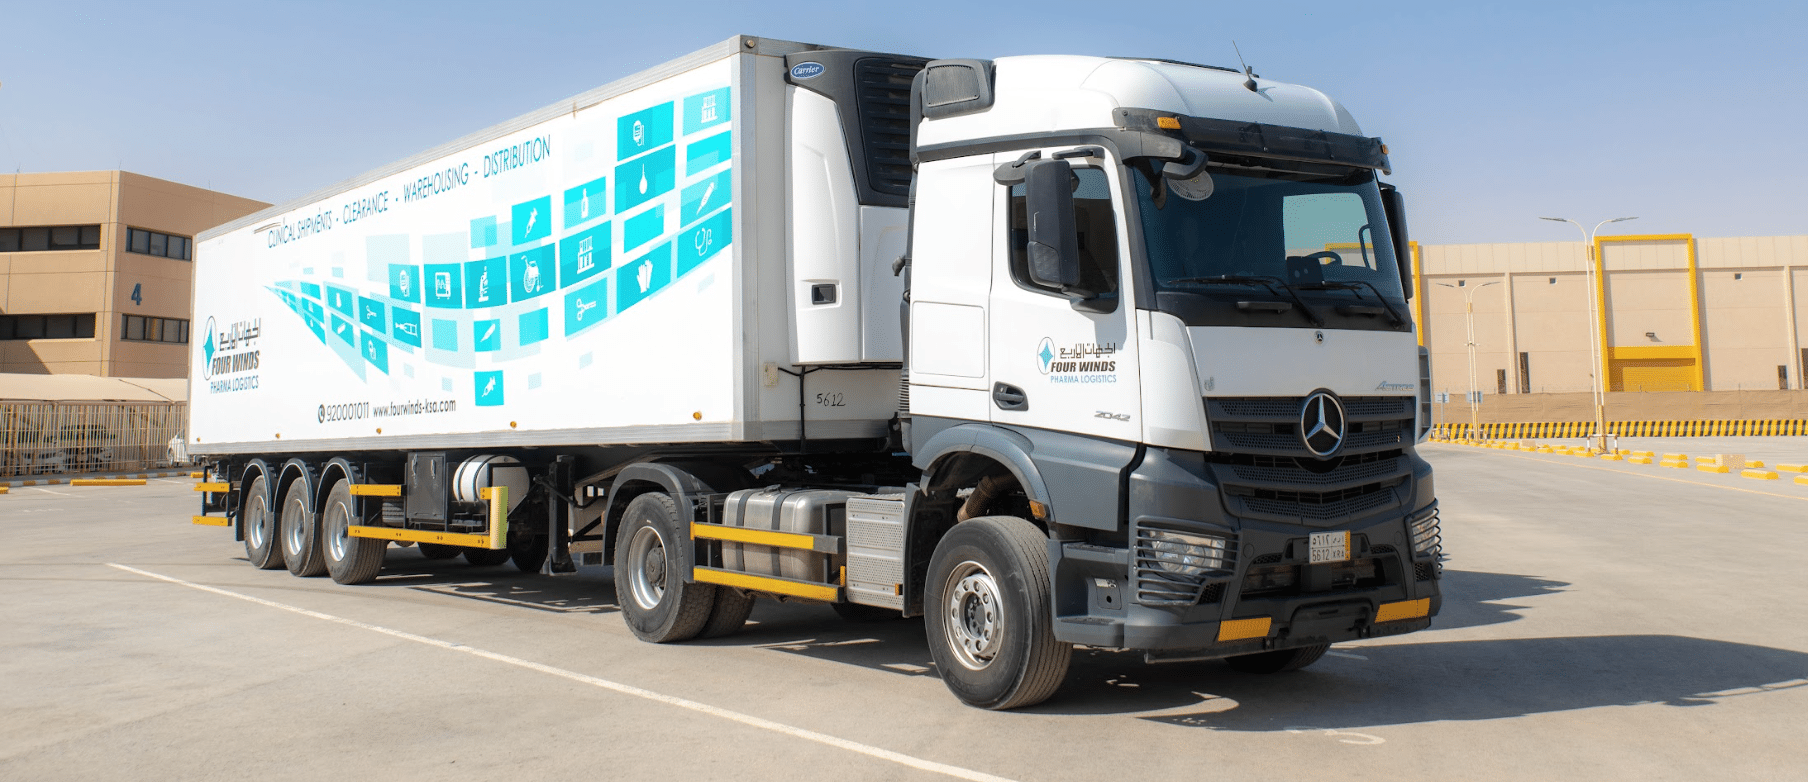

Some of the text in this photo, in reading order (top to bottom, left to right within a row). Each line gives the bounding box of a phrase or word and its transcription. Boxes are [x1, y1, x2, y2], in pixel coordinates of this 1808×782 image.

[793, 65, 820, 75] Carrier
[267, 224, 296, 249] CLINICAL
[297, 210, 333, 240] SHIPMENTS
[343, 190, 389, 225] CLEARANCE
[403, 162, 469, 204] WAREHOUSING
[484, 134, 551, 178] DISTRIBUTION
[131, 283, 142, 306] 4
[211, 349, 260, 376] FOUR WINDS
[1050, 360, 1116, 373] FOUR WINDS
[210, 375, 259, 394] PHARMA LOGISTICS
[1050, 374, 1117, 384] PHARMA LOGISTICS
[816, 392, 846, 407] 5612
[326, 398, 457, 422] 920001011 www.fourwinds-ksa.com
[1094, 410, 1131, 422] 2042
[1312, 549, 1330, 562] 5612
